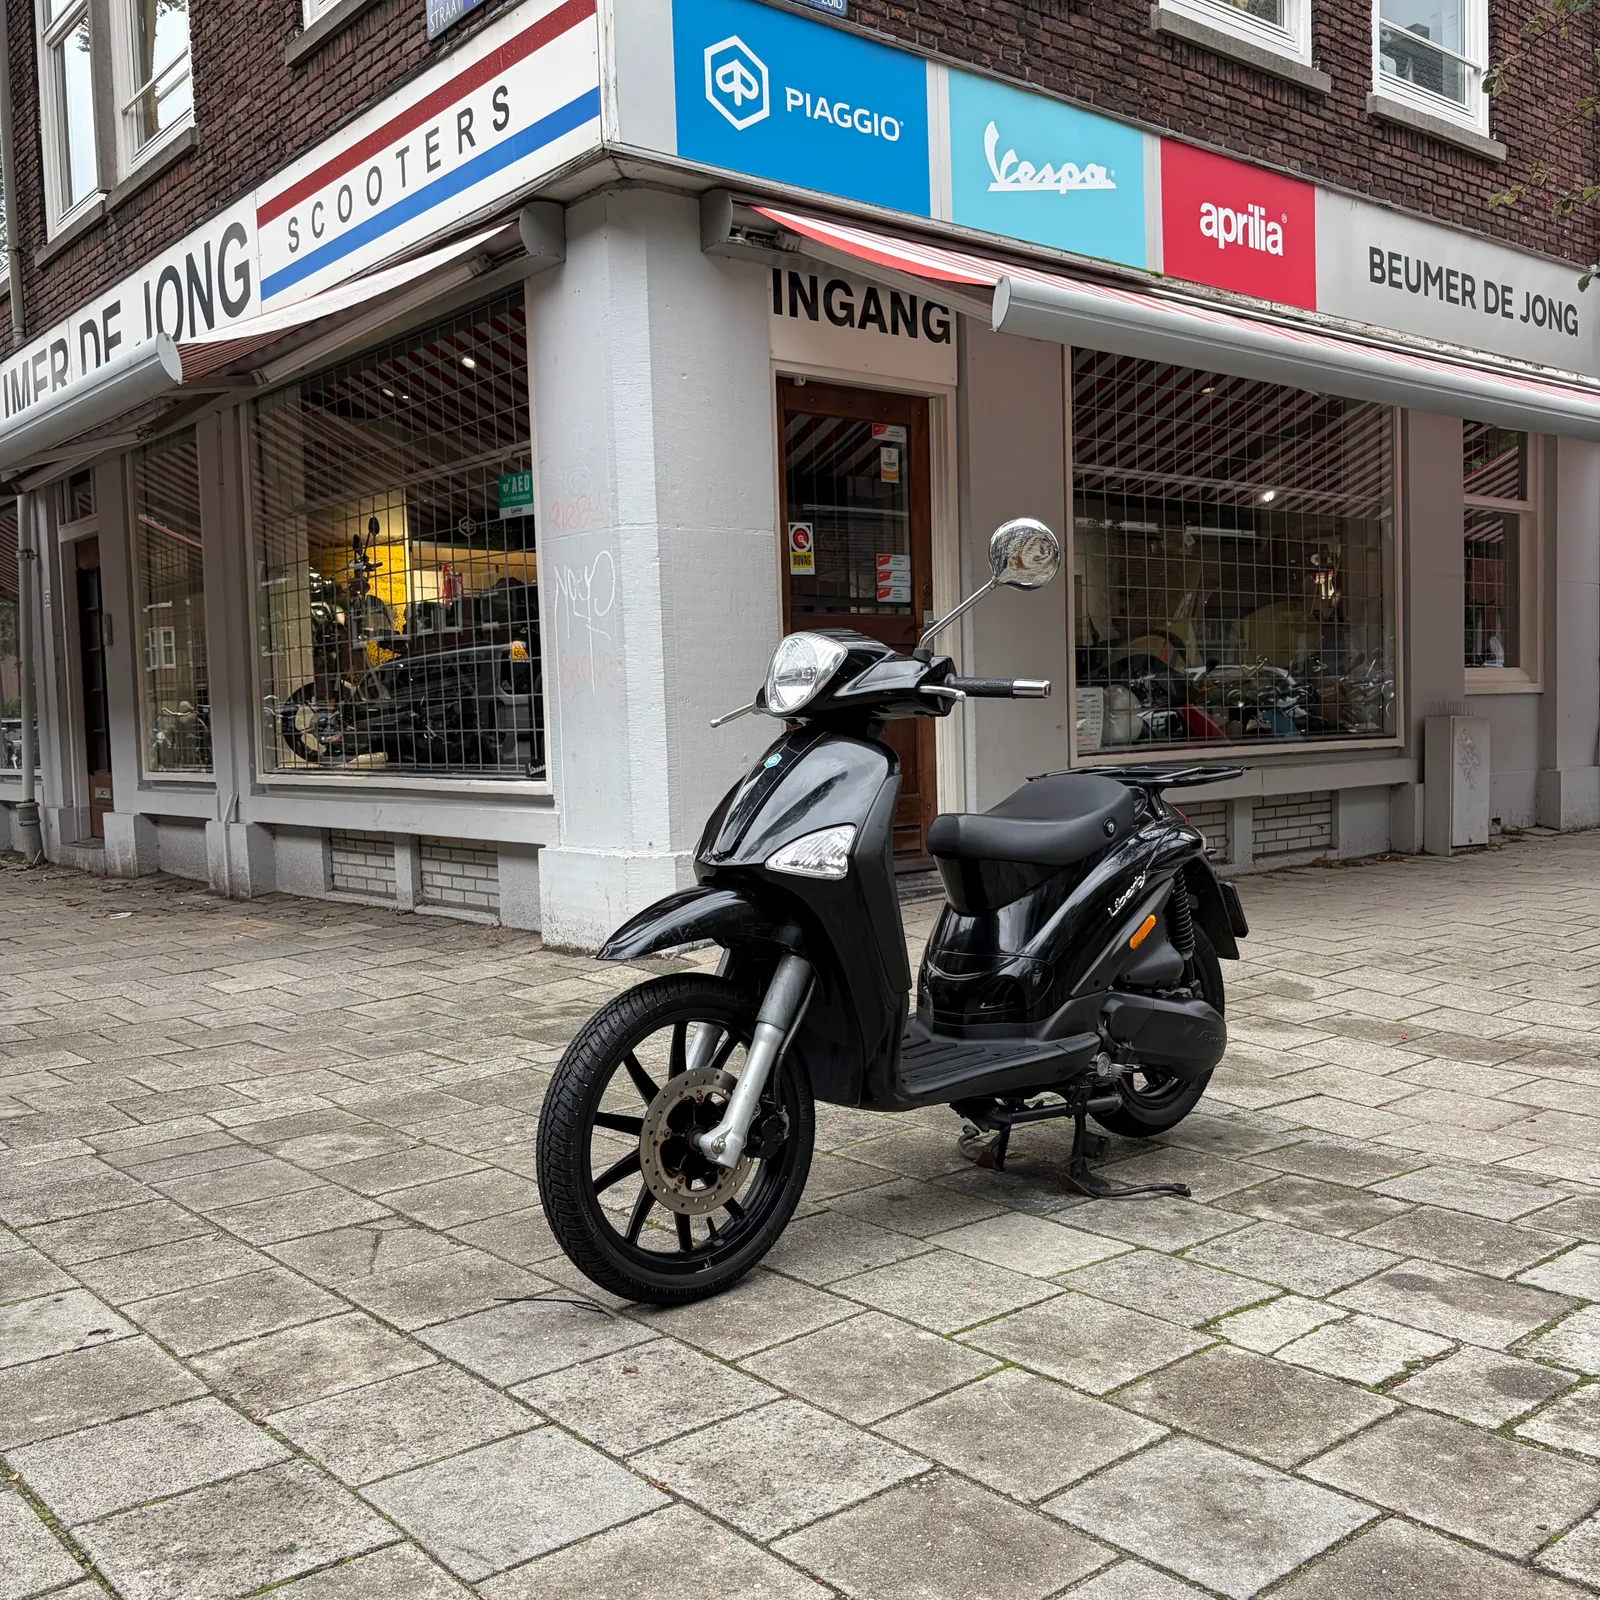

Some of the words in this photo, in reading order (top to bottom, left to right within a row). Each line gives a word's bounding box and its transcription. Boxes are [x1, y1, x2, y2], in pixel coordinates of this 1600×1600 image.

[785, 87, 900, 142] PIAGGIO
[287, 85, 511, 254] SCOOTERS
[984, 120, 1117, 194] Vespa
[1200, 202, 1283, 256] aprilia
[772, 268, 951, 344] INGANG
[1369, 246, 1476, 310] BEUMER
[1484, 280, 1514, 319] DE
[1520, 291, 1579, 337] JONG
[511, 474, 530, 494] AED
[793, 555, 811, 566] BOVAG
[1107, 870, 1146, 917] Liberty
